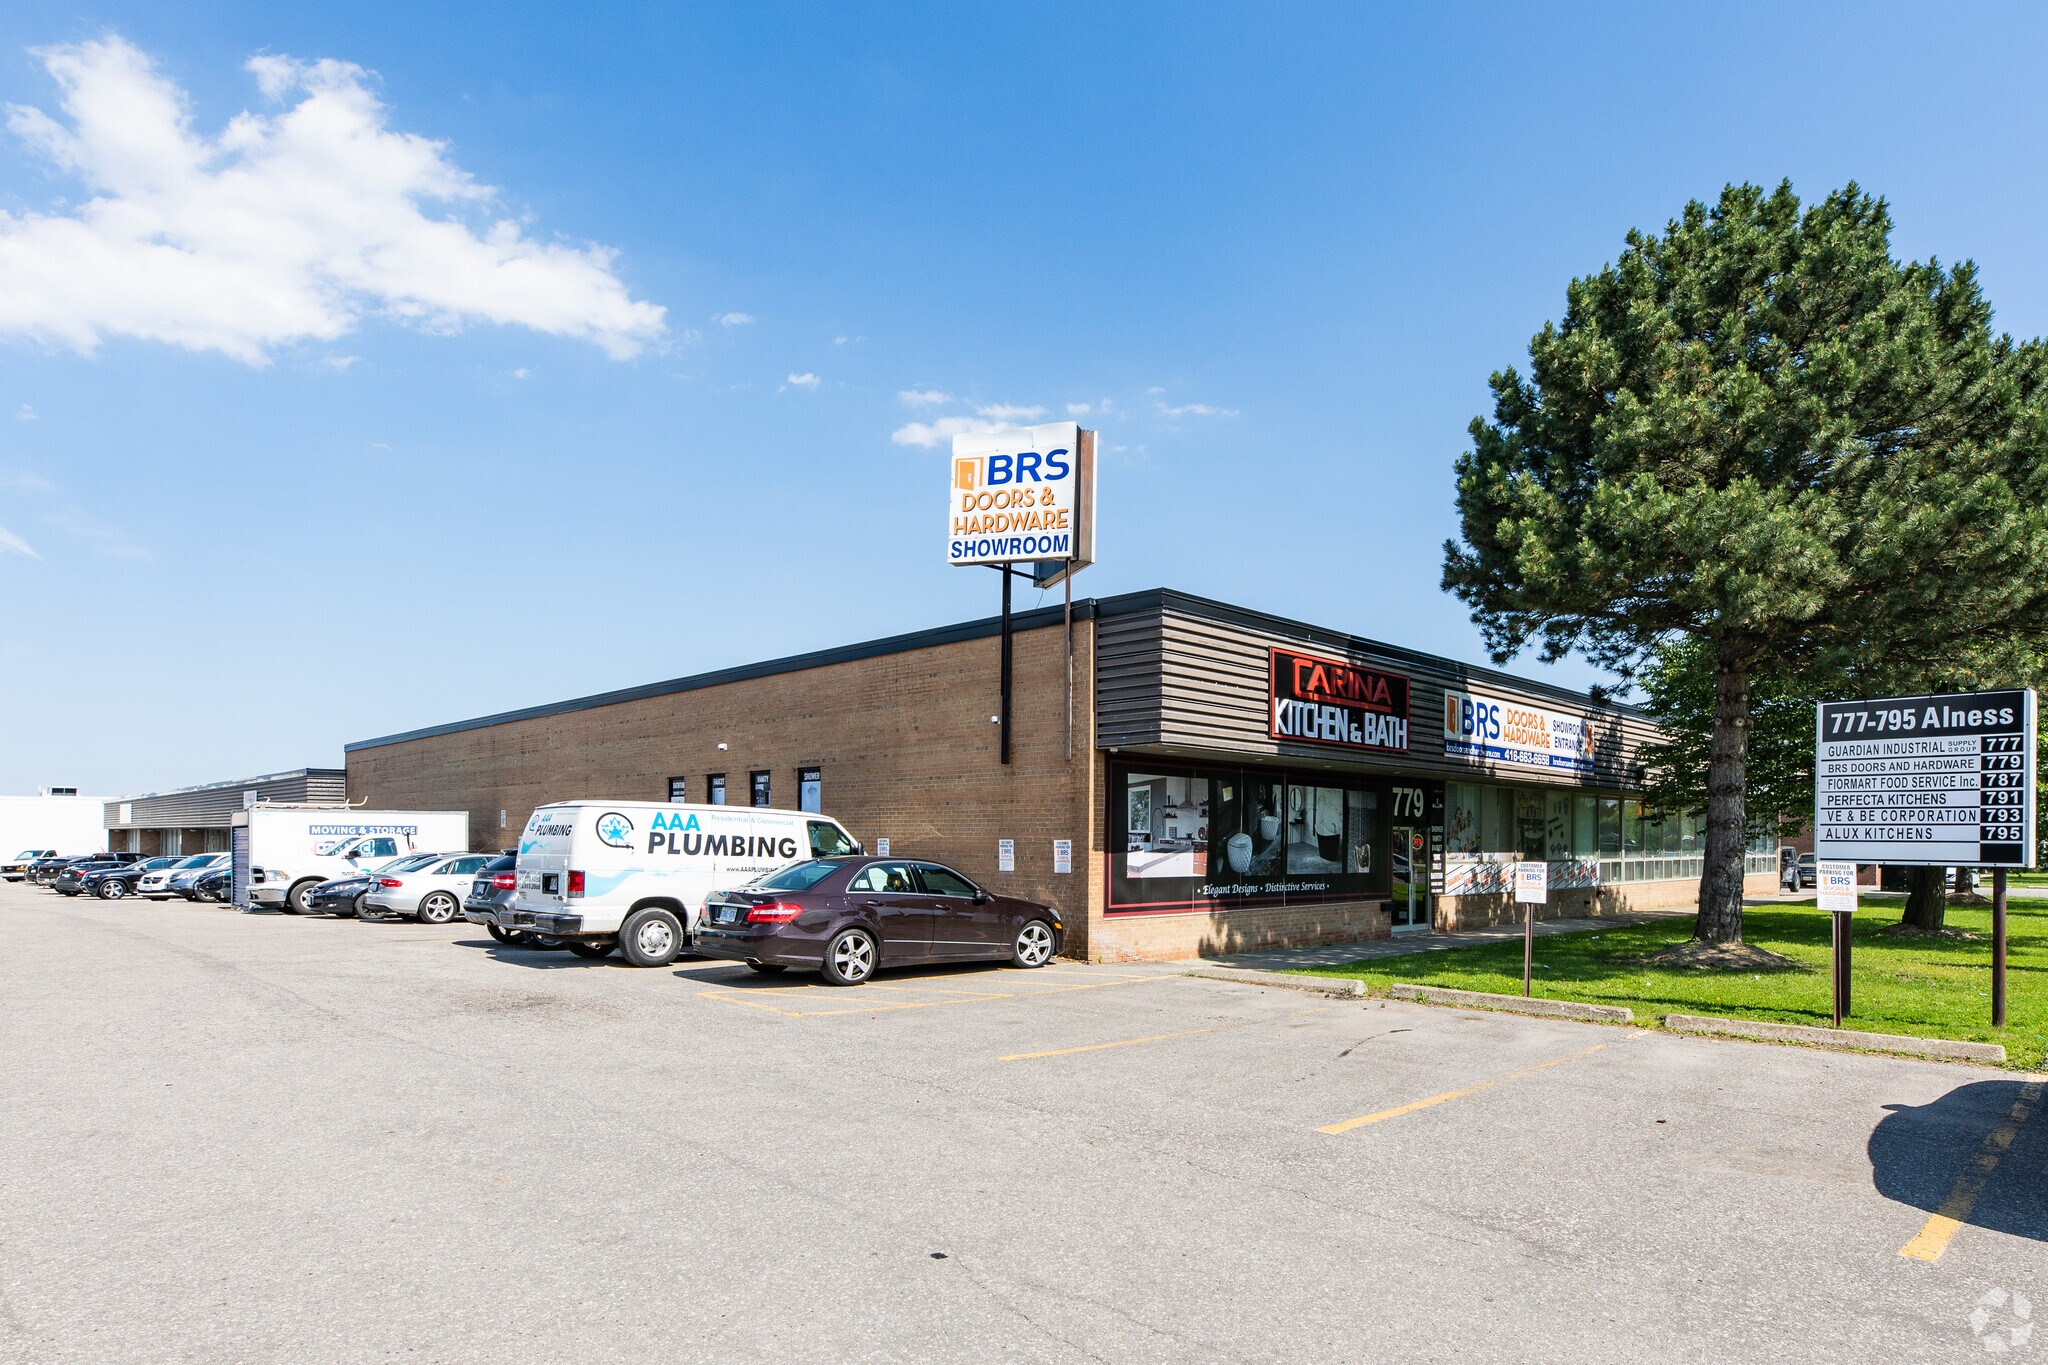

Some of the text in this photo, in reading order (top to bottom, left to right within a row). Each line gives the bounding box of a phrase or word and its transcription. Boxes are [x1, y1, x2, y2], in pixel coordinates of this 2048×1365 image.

[987, 449, 1070, 486] BRS
[962, 486, 1055, 513] DOORS &
[953, 508, 1069, 536] HARDWARE
[951, 534, 1069, 559] SHOWROOM
[1293, 658, 1393, 713] CARINA
[1273, 697, 1408, 750] KITCHEN & BATH
[1461, 698, 1500, 740] BRS
[1507, 708, 1546, 732] DOORS &
[1831, 705, 2014, 734] 777-795 Alness
[1503, 725, 1551, 749] HARDWARE
[1986, 737, 2021, 751] 777
[1828, 741, 1945, 757] GUARDIAN INDUSTRIAL
[1504, 749, 1550, 766] 416-663-6658
[1986, 755, 2021, 769] 779
[1828, 759, 1975, 773] BRS DOORS AND HARDWARE
[803, 771, 821, 781] SHOWER
[1828, 775, 1978, 790] FIORMART FOOD SERVICE Inc.
[1986, 773, 2021, 787] 787
[1392, 787, 1424, 818] 779
[1827, 793, 1947, 806] PERFECTA KITCHENS
[1986, 791, 2019, 805] 791
[651, 811, 701, 832] AAA
[711, 814, 749, 823] Residential
[757, 817, 794, 826] Commercial
[1827, 809, 1977, 822] VE & BE CORPORATION
[1986, 809, 2021, 822] 793
[310, 826, 416, 834] MOVING & STORAGE
[534, 824, 573, 837] PLUMBING
[1825, 827, 1933, 840] ALUX KITCHENS
[1985, 826, 2021, 840] 795
[647, 831, 798, 859] PLUMBING
[1830, 876, 1851, 885] BRS
[1203, 881, 1326, 897] Elegant Designs Distinctive Services
